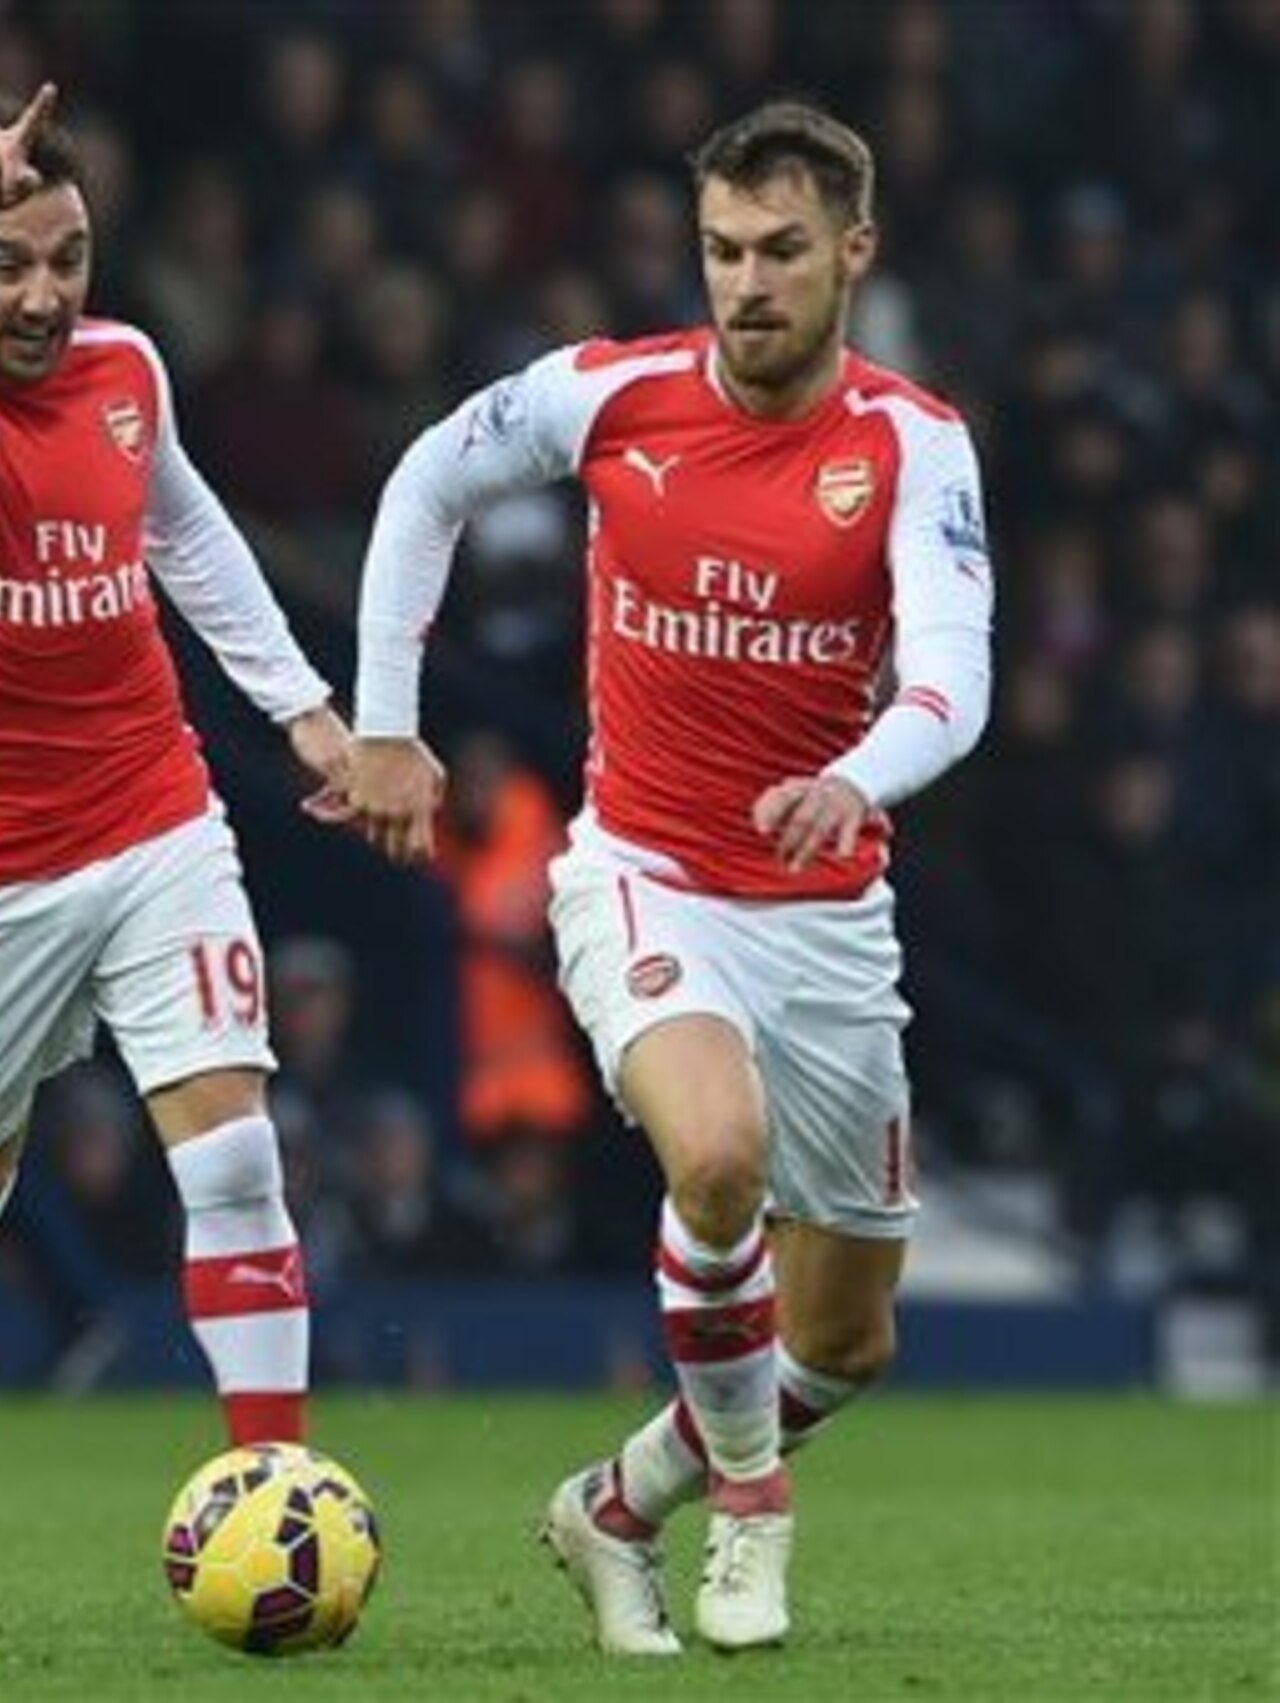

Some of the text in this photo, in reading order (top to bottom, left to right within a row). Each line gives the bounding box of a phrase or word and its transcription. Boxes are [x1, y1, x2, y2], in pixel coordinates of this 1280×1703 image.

[35, 519, 105, 564] Fly
[695, 556, 777, 612] Fly
[613, 576, 860, 664] Emirates
[190, 940, 259, 1026] 19
